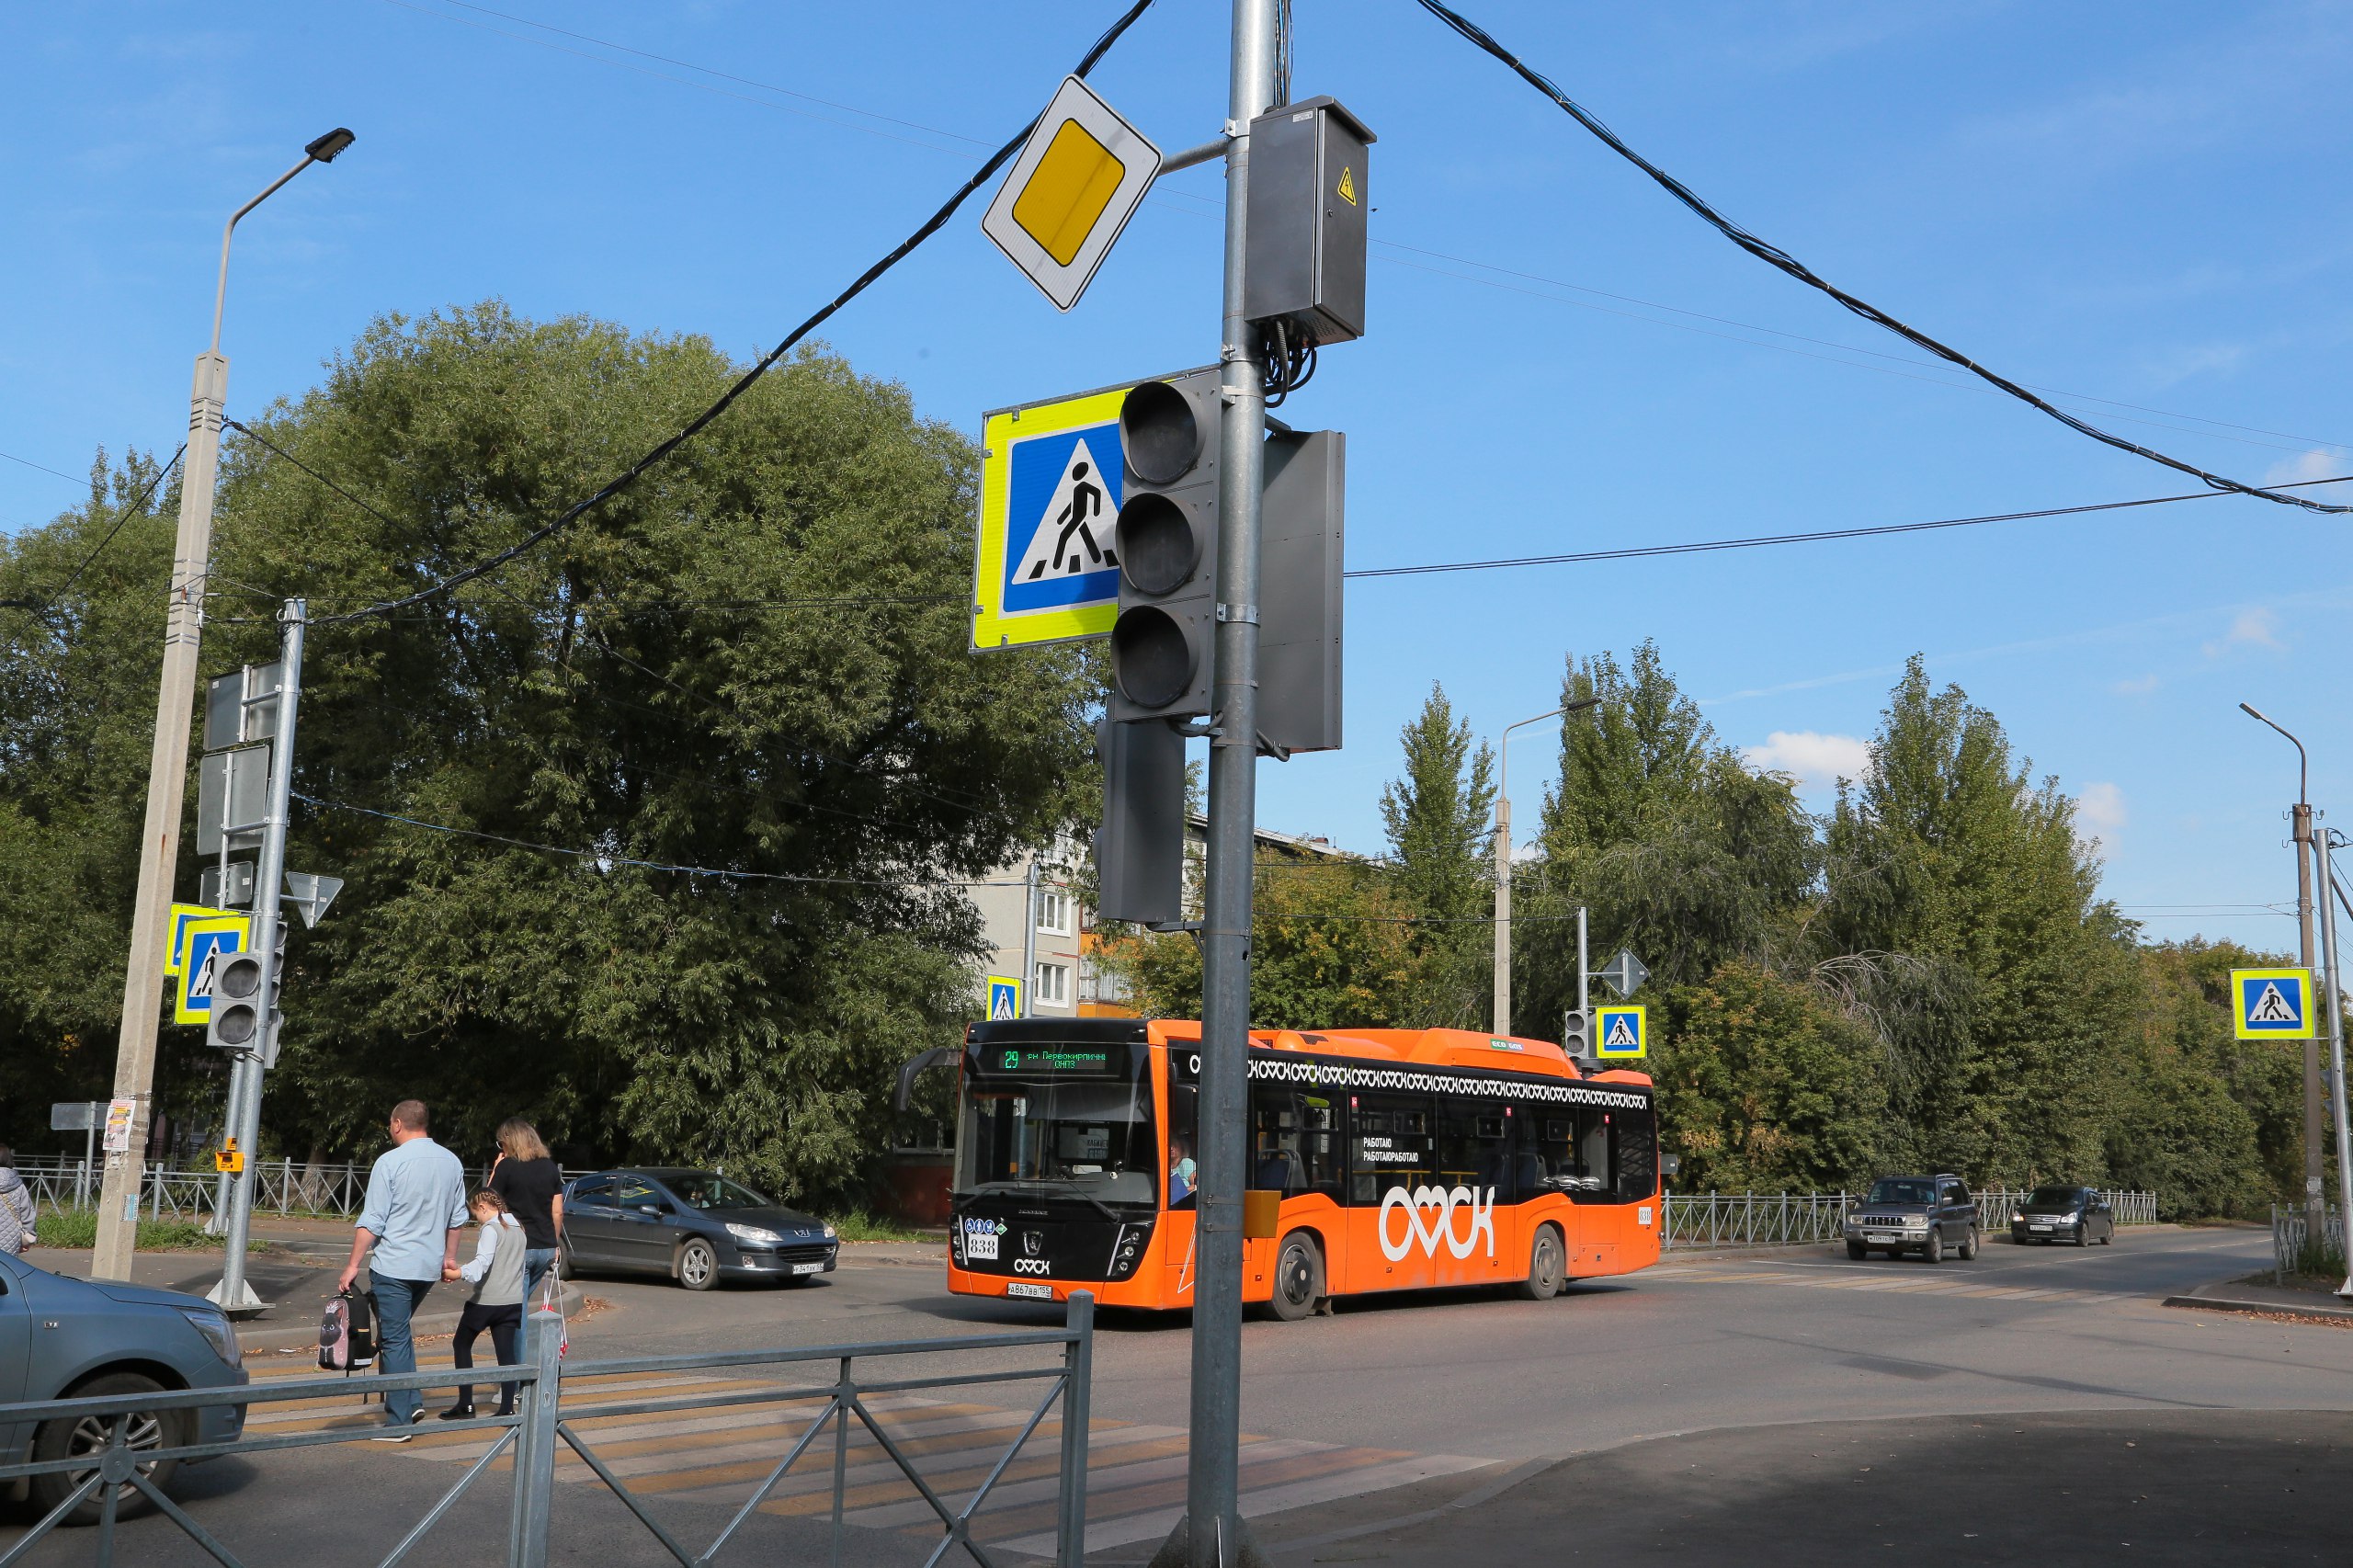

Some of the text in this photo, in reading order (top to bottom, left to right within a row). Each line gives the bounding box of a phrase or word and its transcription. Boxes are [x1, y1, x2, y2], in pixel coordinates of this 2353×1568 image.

[1005, 1051, 1018, 1068] 29
[1054, 1060, 1075, 1069] ОНПЗ
[1363, 1137, 1392, 1148] РАБОТАЮ
[1363, 1151, 1418, 1162] РАБОТАЮРАБОТАЮ
[1640, 1210, 1651, 1221] 838
[1379, 1185, 1495, 1261] ОМСК
[971, 1238, 995, 1254] 838
[1014, 1258, 1050, 1275] ОМСК
